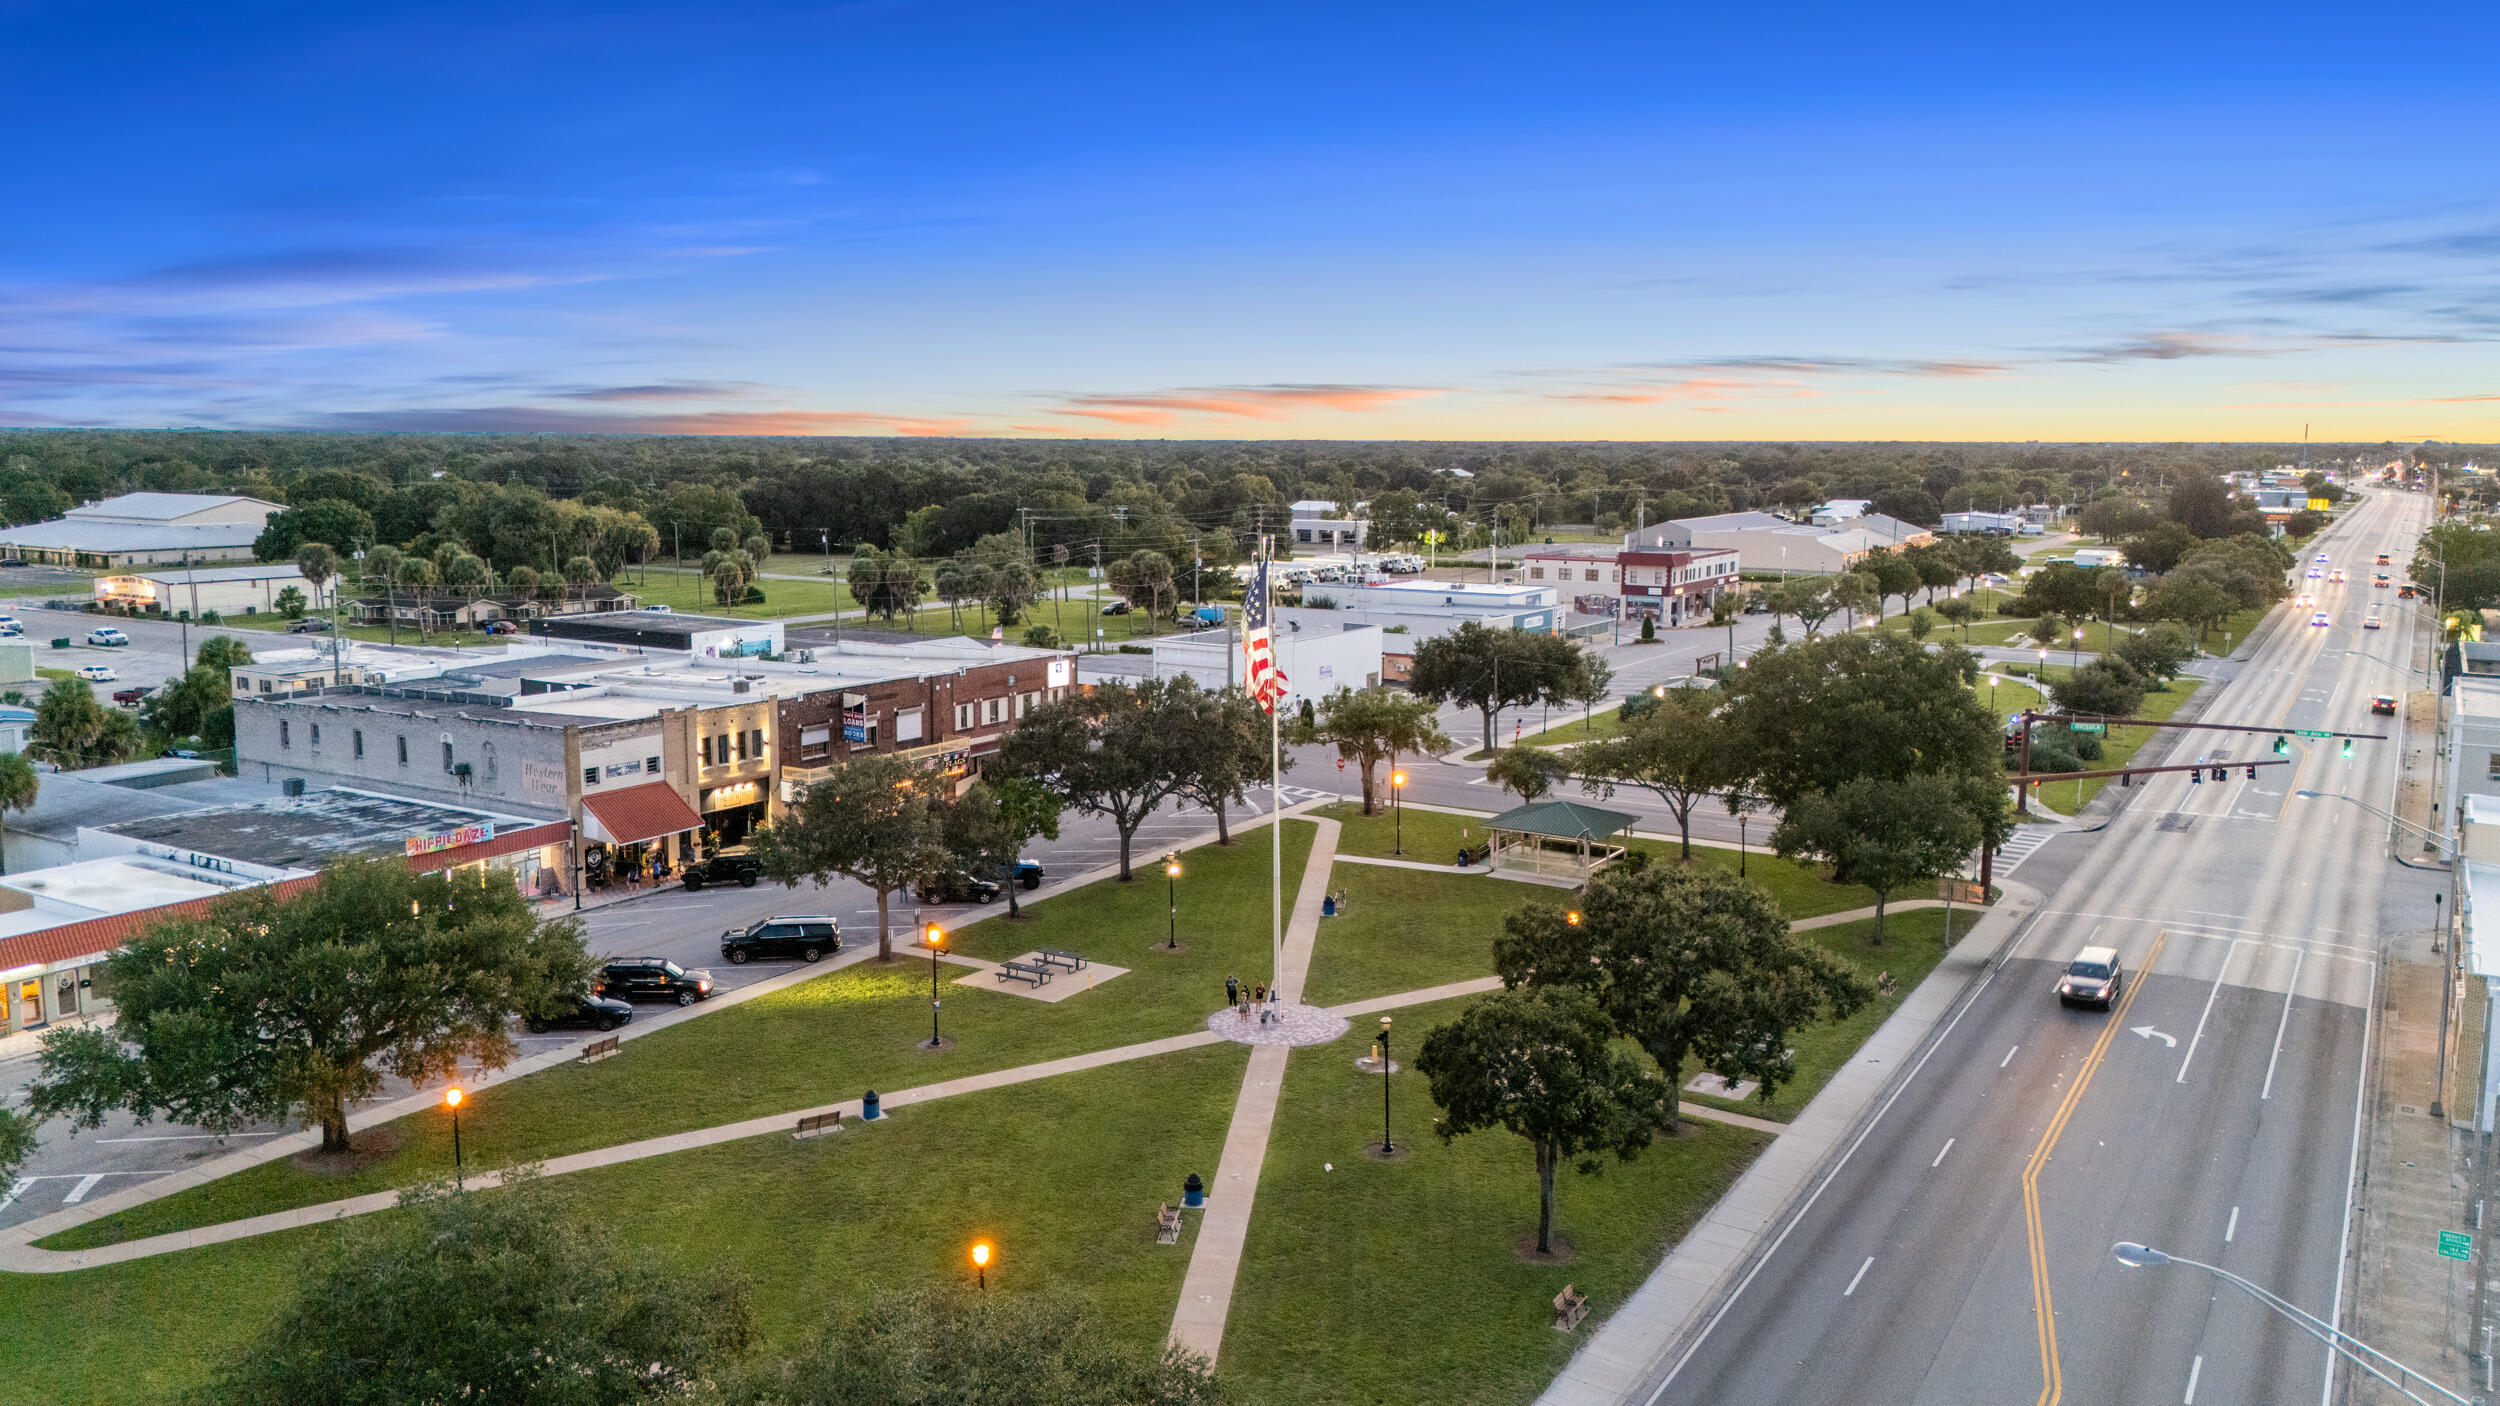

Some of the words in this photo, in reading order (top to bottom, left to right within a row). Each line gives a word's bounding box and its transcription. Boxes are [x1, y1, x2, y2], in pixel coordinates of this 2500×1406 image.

[844, 718, 864, 727] LOANS
[844, 730, 864, 739] BOOKS
[945, 758, 966, 767] FLAGS
[525, 763, 564, 780] Western
[531, 779, 558, 794] Wear
[415, 834, 453, 852] HIPPIE
[454, 827, 487, 843] DAZE
